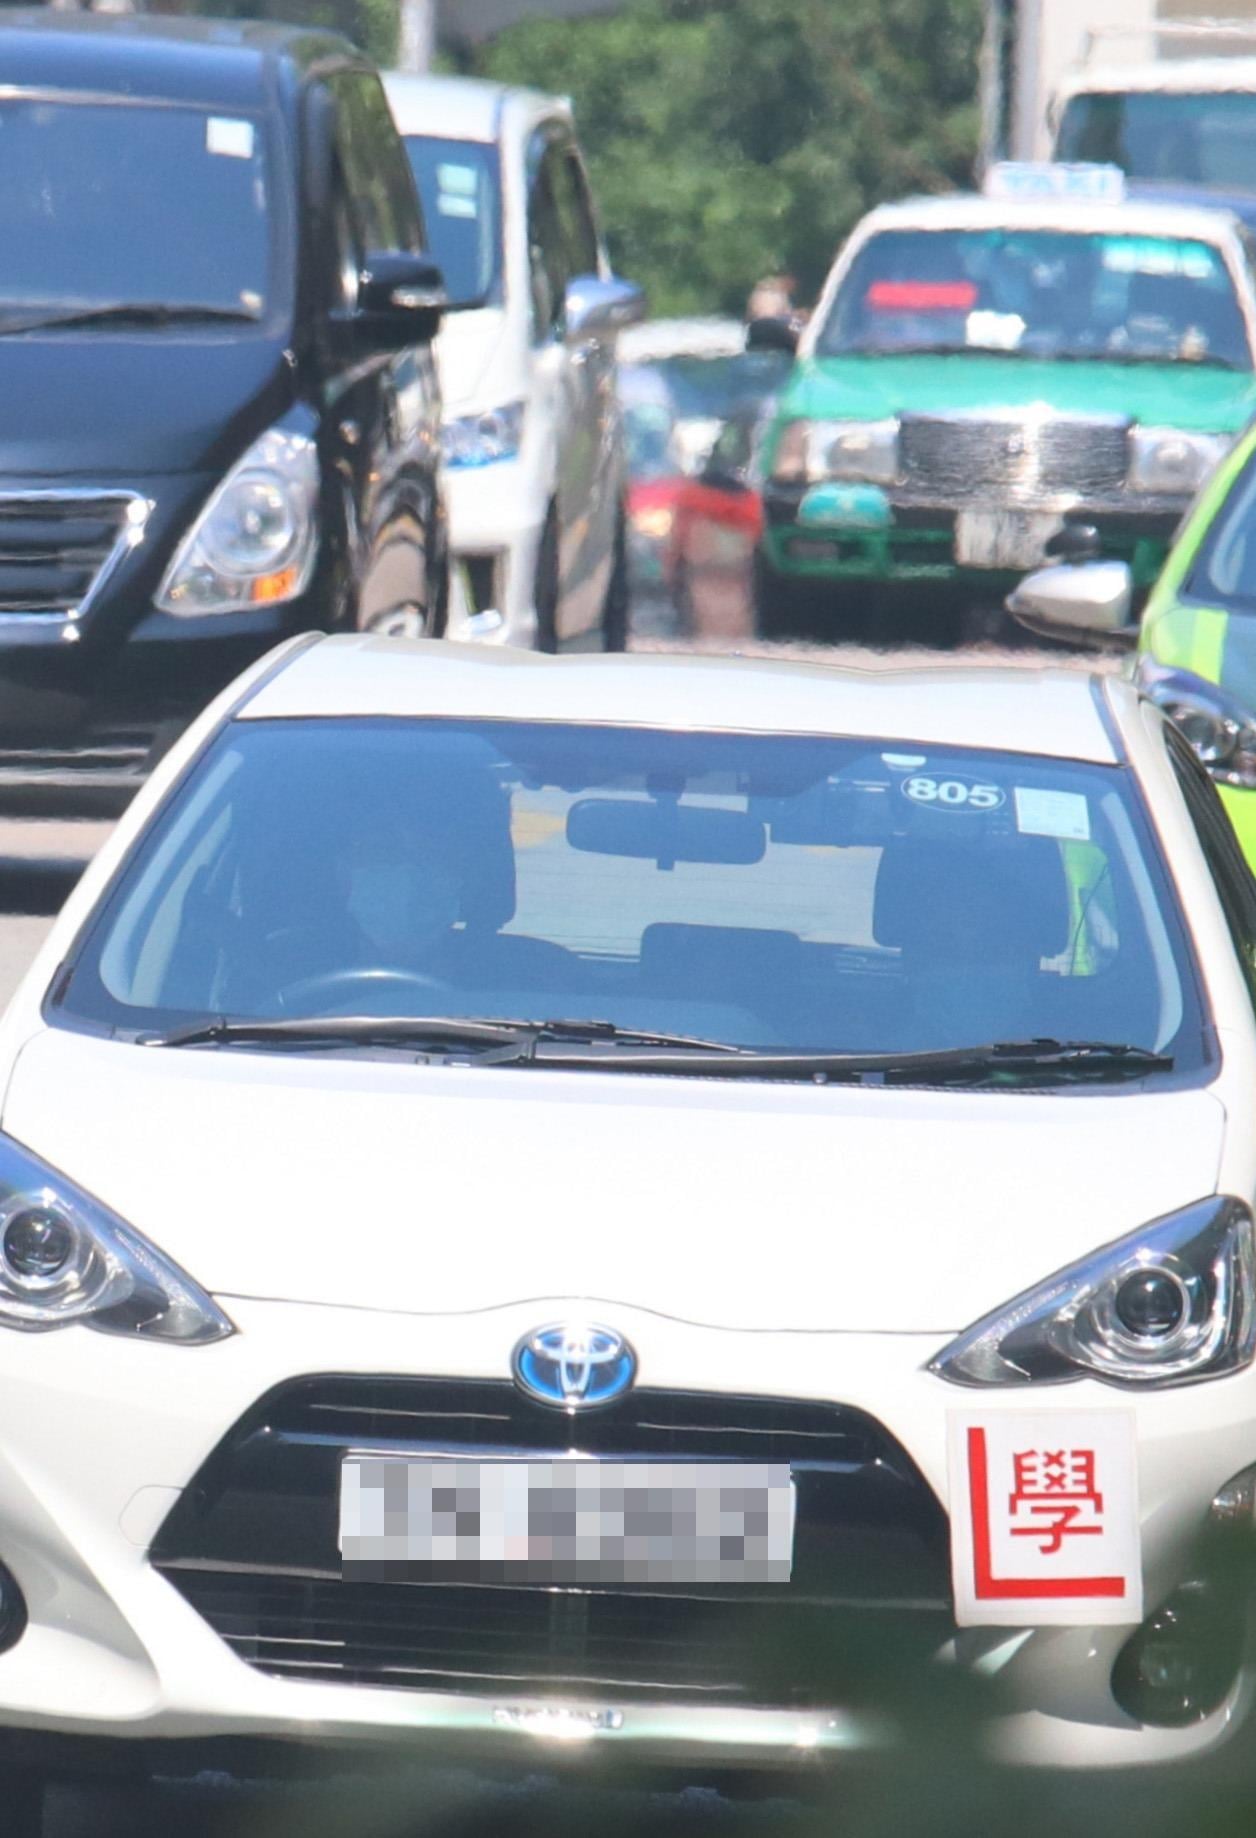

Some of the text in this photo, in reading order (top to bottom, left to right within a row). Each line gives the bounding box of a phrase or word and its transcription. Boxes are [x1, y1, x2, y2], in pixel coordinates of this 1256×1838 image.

[907, 777, 999, 807] 805
[967, 1427, 1125, 1600] L
[1008, 1449, 1103, 1555] 學
